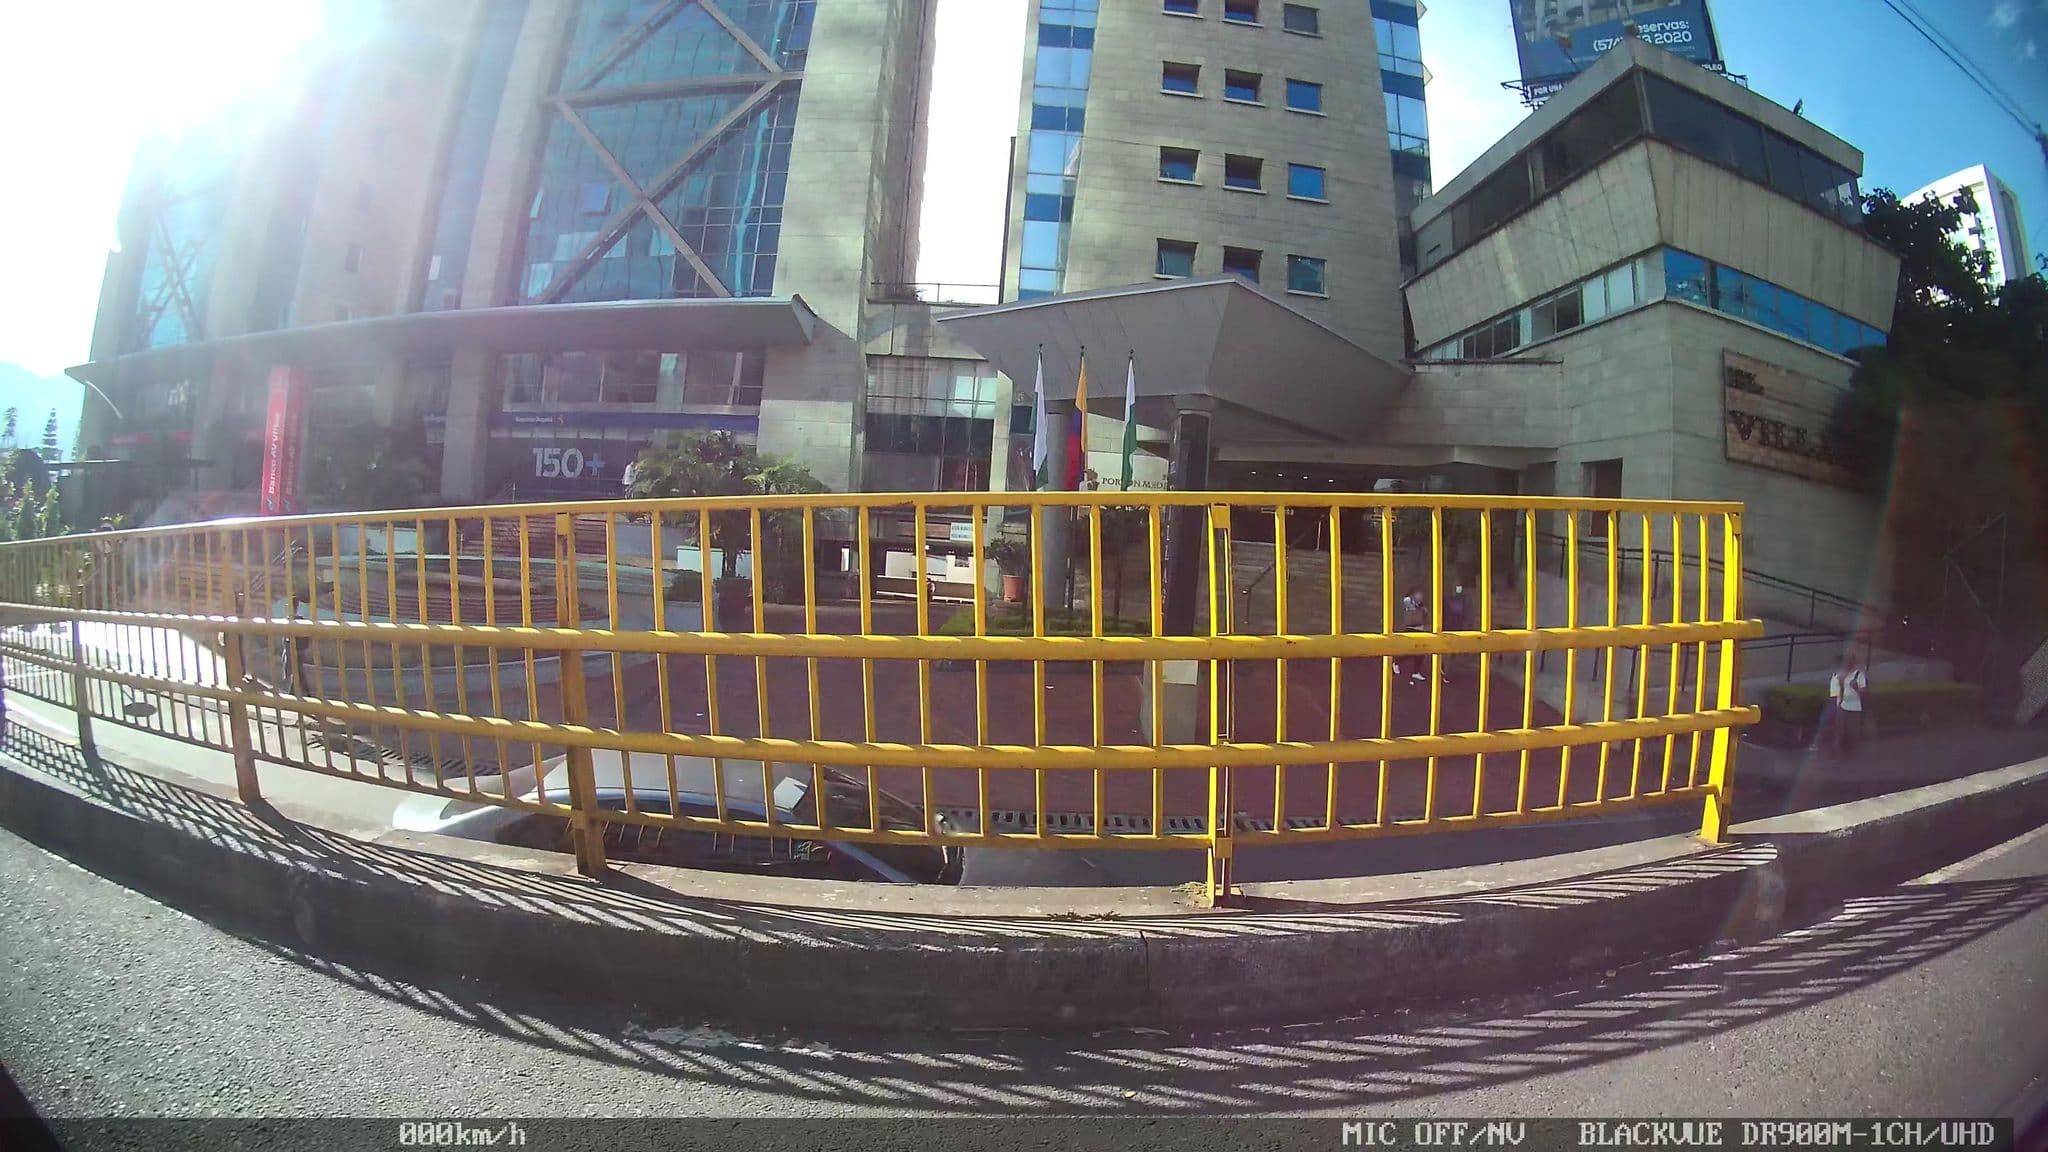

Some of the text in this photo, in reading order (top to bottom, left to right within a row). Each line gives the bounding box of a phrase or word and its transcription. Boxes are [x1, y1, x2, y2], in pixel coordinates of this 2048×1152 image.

[1638, 20, 1690, 33] eservas:
[1654, 31, 1692, 44] 2020
[268, 460, 278, 494] Banco
